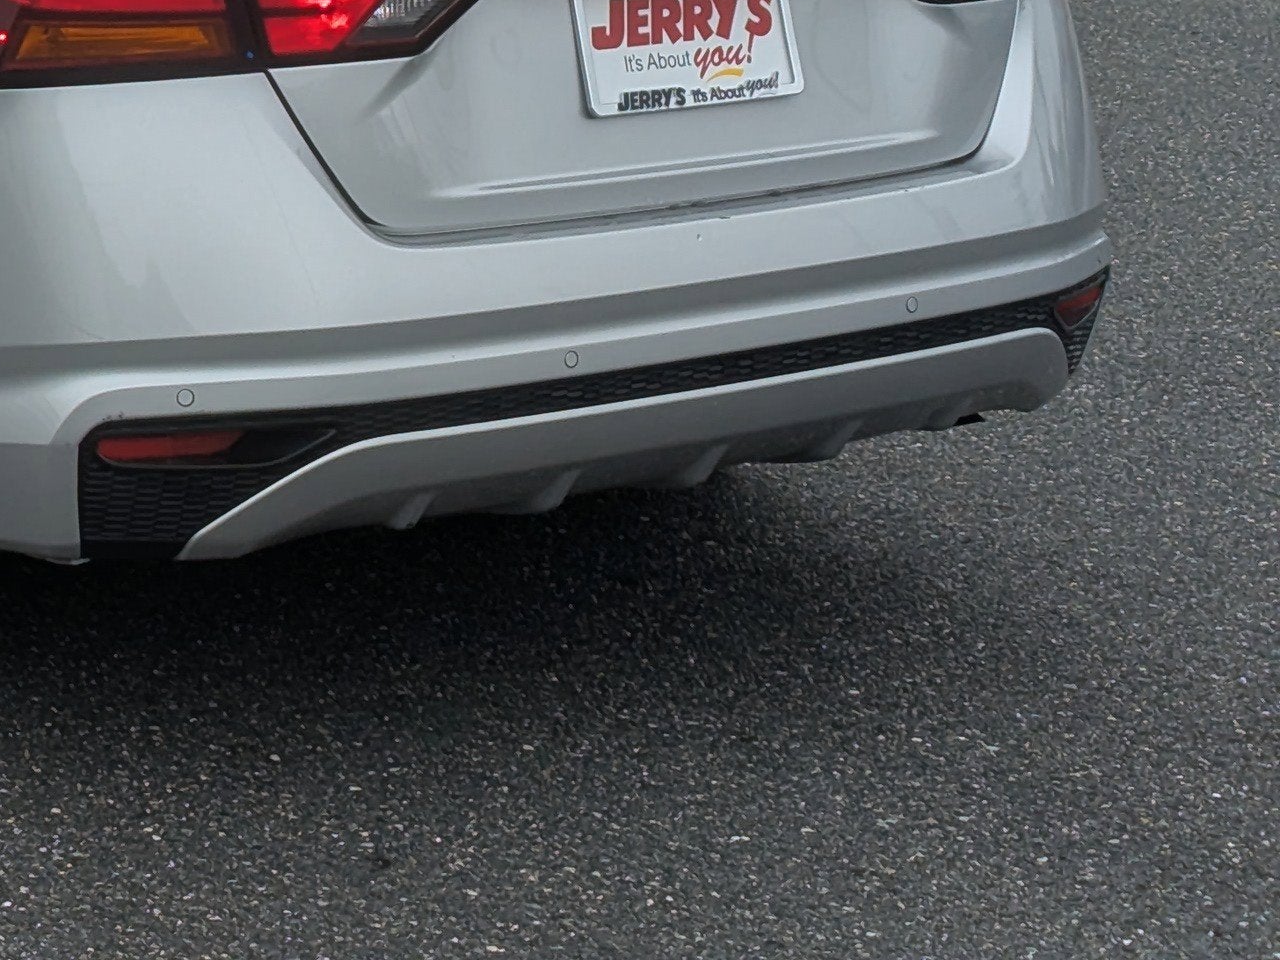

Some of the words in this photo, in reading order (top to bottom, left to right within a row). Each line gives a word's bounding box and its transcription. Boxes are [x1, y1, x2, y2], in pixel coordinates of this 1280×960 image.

[624, 53, 644, 73] It's
[647, 50, 692, 71] About
[693, 32, 754, 82] you!
[617, 86, 687, 112] JERRY'S
[709, 84, 747, 101] About
